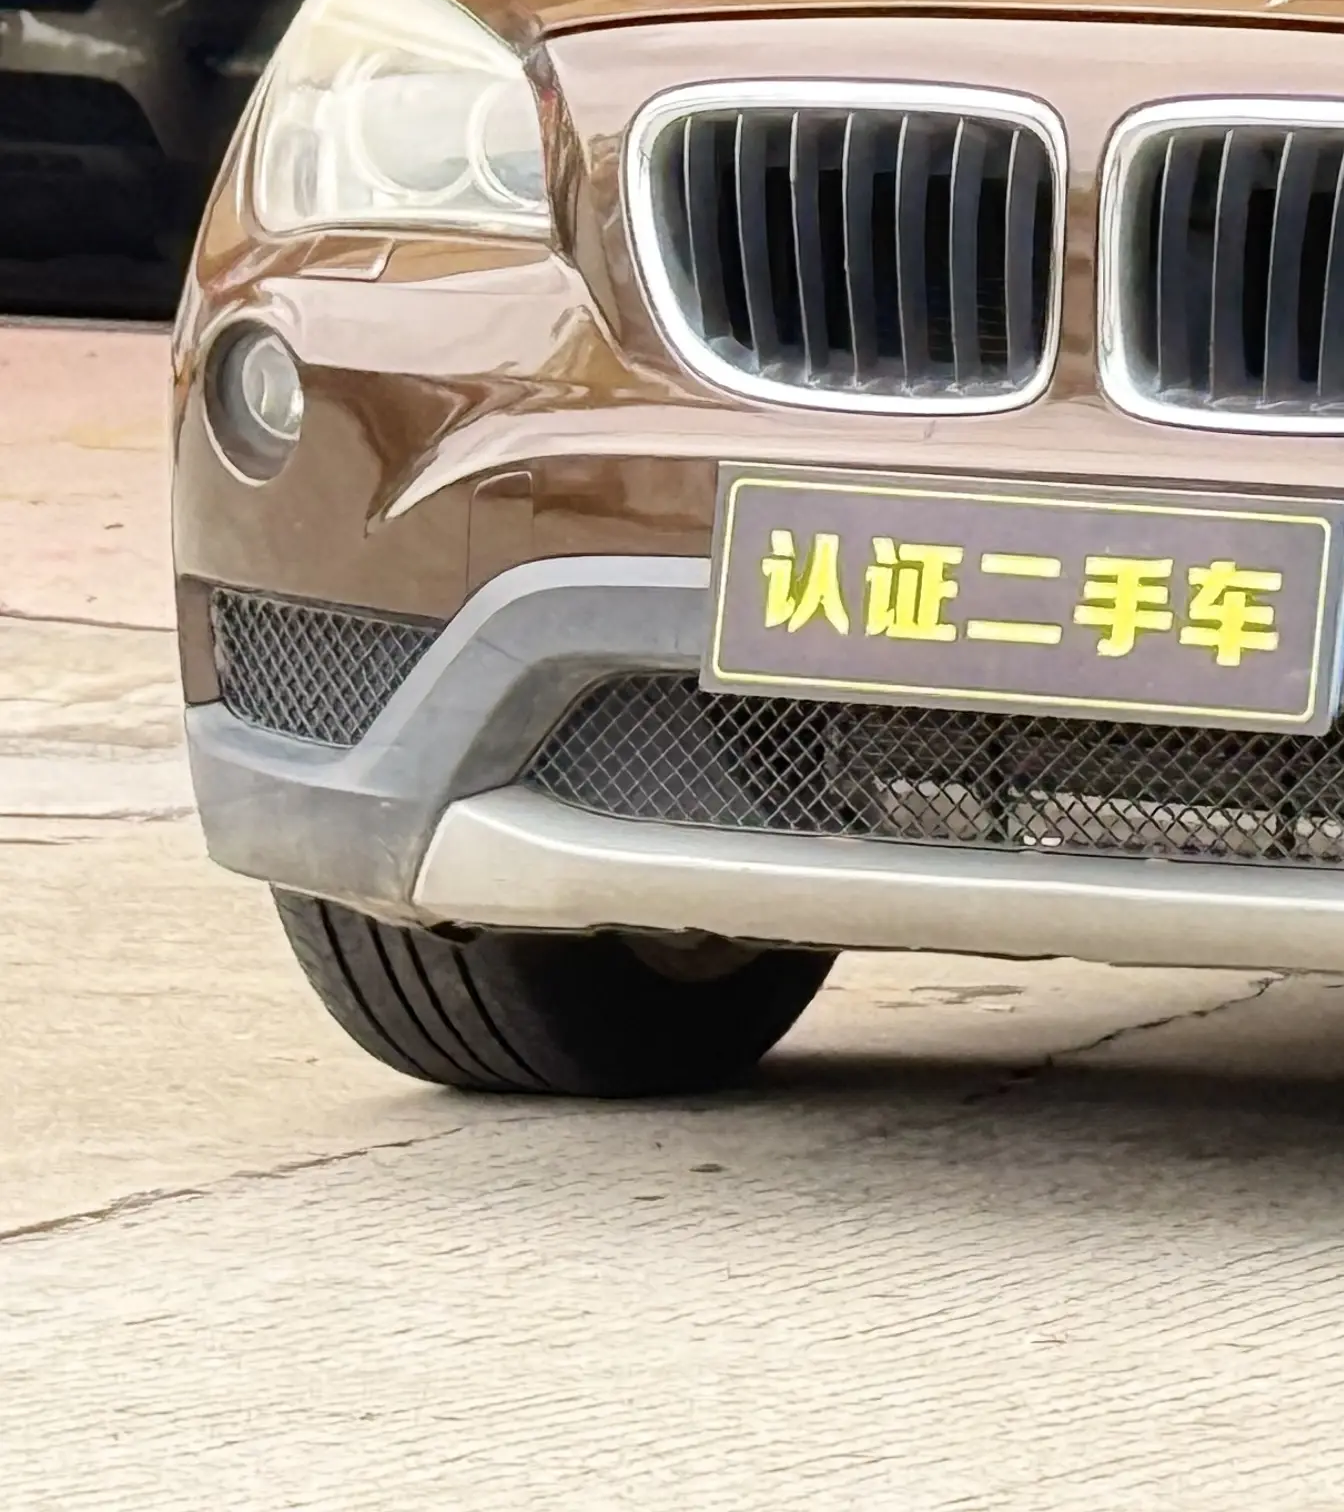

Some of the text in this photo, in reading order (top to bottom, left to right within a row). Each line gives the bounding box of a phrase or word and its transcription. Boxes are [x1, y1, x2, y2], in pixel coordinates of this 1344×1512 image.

[761, 530, 1282, 667] 认证二手车
